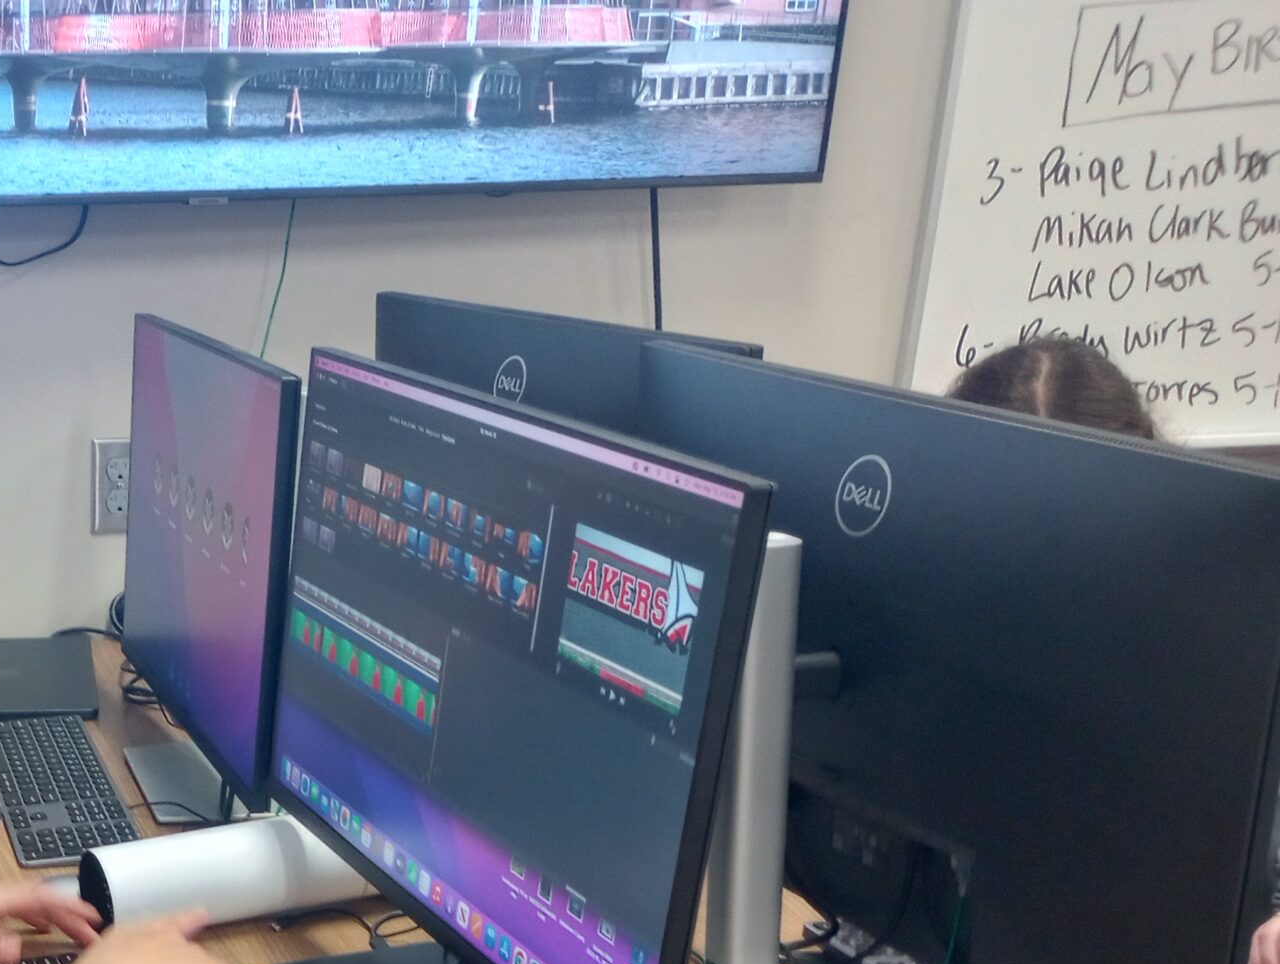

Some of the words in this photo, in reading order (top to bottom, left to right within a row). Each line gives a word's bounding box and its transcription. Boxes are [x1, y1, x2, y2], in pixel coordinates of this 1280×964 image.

[1086, 14, 1194, 113] May
[1039, 145, 1131, 198] Paige
[1032, 212, 1133, 253] Mikan
[1148, 203, 1231, 243] Clark
[1028, 261, 1096, 302] Lake
[1109, 261, 1210, 301] Olson
[1124, 315, 1222, 355] Wirtz
[497, 374, 521, 393] DELL
[842, 481, 882, 511] DELL
[566, 550, 671, 630] LAKERS
